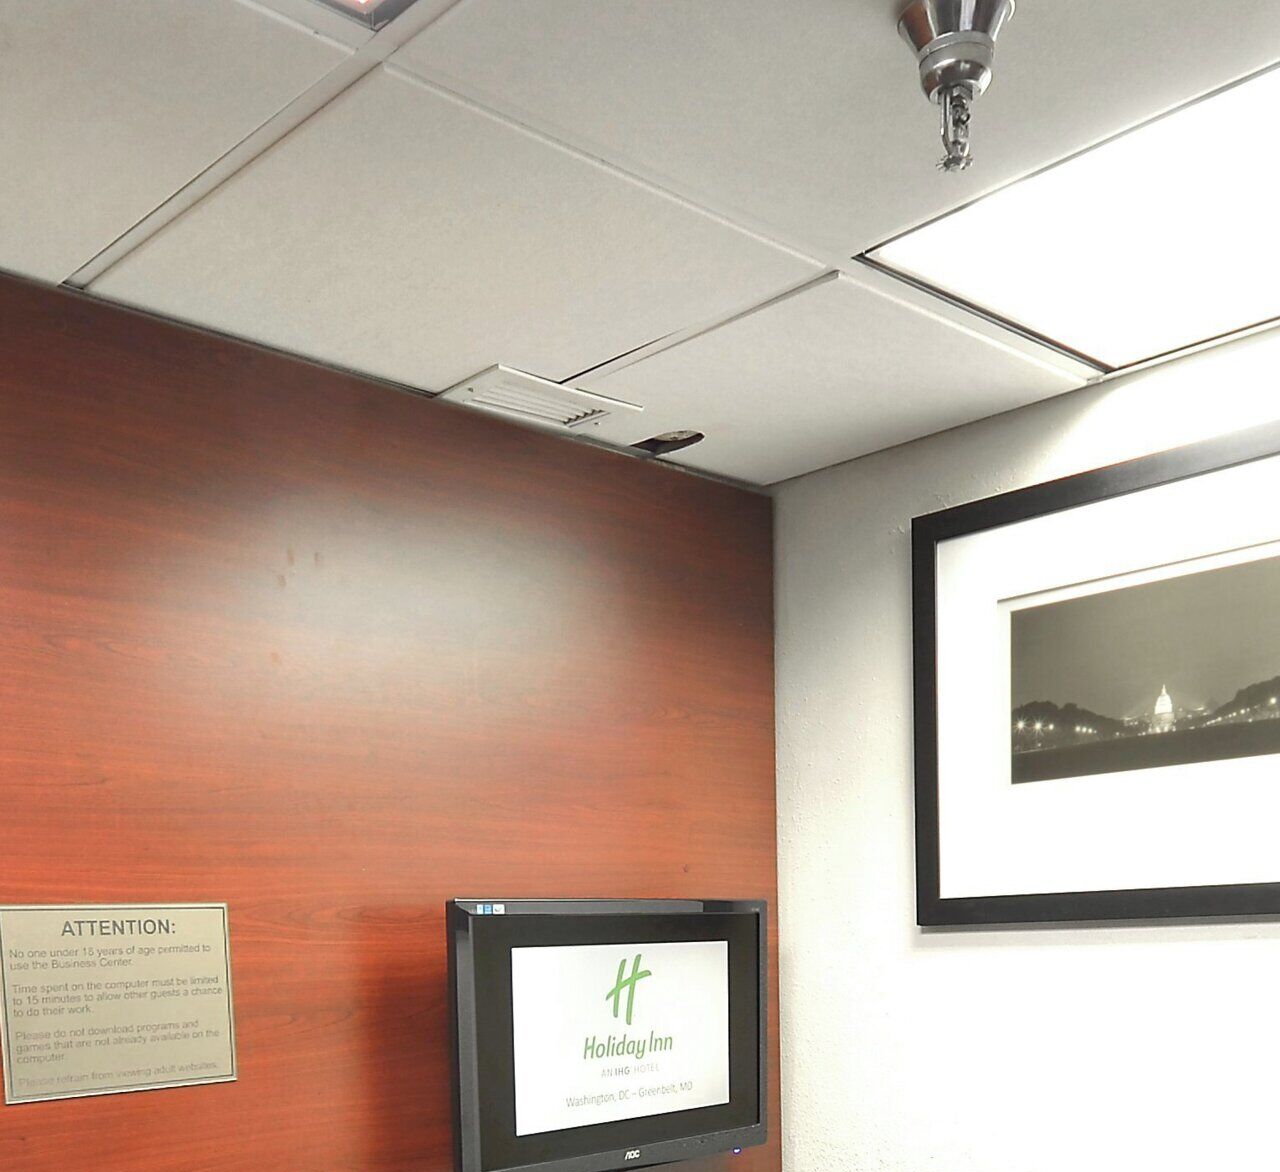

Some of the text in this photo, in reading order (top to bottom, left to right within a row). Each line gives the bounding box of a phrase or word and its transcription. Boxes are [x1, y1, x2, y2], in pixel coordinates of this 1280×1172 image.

[61, 919, 175, 936] ATTENTION:
[10, 949, 24, 958] No
[27, 950, 46, 958] one
[50, 948, 78, 958] under
[96, 946, 124, 958] years
[126, 946, 135, 955] of
[138, 946, 156, 956] age
[158, 944, 200, 955] permitted
[202, 944, 212, 952] to
[10, 962, 29, 970] use
[32, 960, 48, 970] the
[52, 959, 96, 968] Business
[12, 976, 218, 994] Time spent on the computer must be limited
[12, 998, 22, 1006] to
[42, 994, 80, 1004] minutes
[84, 993, 94, 1002] to
[96, 992, 121, 1001] allow
[124, 990, 148, 1000] other
[150, 988, 180, 1000] guests
[190, 986, 222, 995] chance
[13, 1008, 24, 1017] to
[26, 1008, 40, 1016] do
[42, 1006, 65, 1016] their
[16, 1020, 198, 1040] Please do not download programs and
[16, 1044, 51, 1055] games
[54, 1040, 72, 1049] that
[76, 1040, 92, 1048] are
[94, 1036, 110, 1046] not
[192, 1030, 204, 1038] on
[584, 1030, 673, 1060] Holiday Inn
[601, 1063, 660, 1078] AN IHG HOTEL
[566, 1093, 617, 1108] Washington,
[618, 1089, 630, 1101] DC
[638, 1084, 678, 1098] Greenbelt,
[680, 1080, 693, 1092] MD
